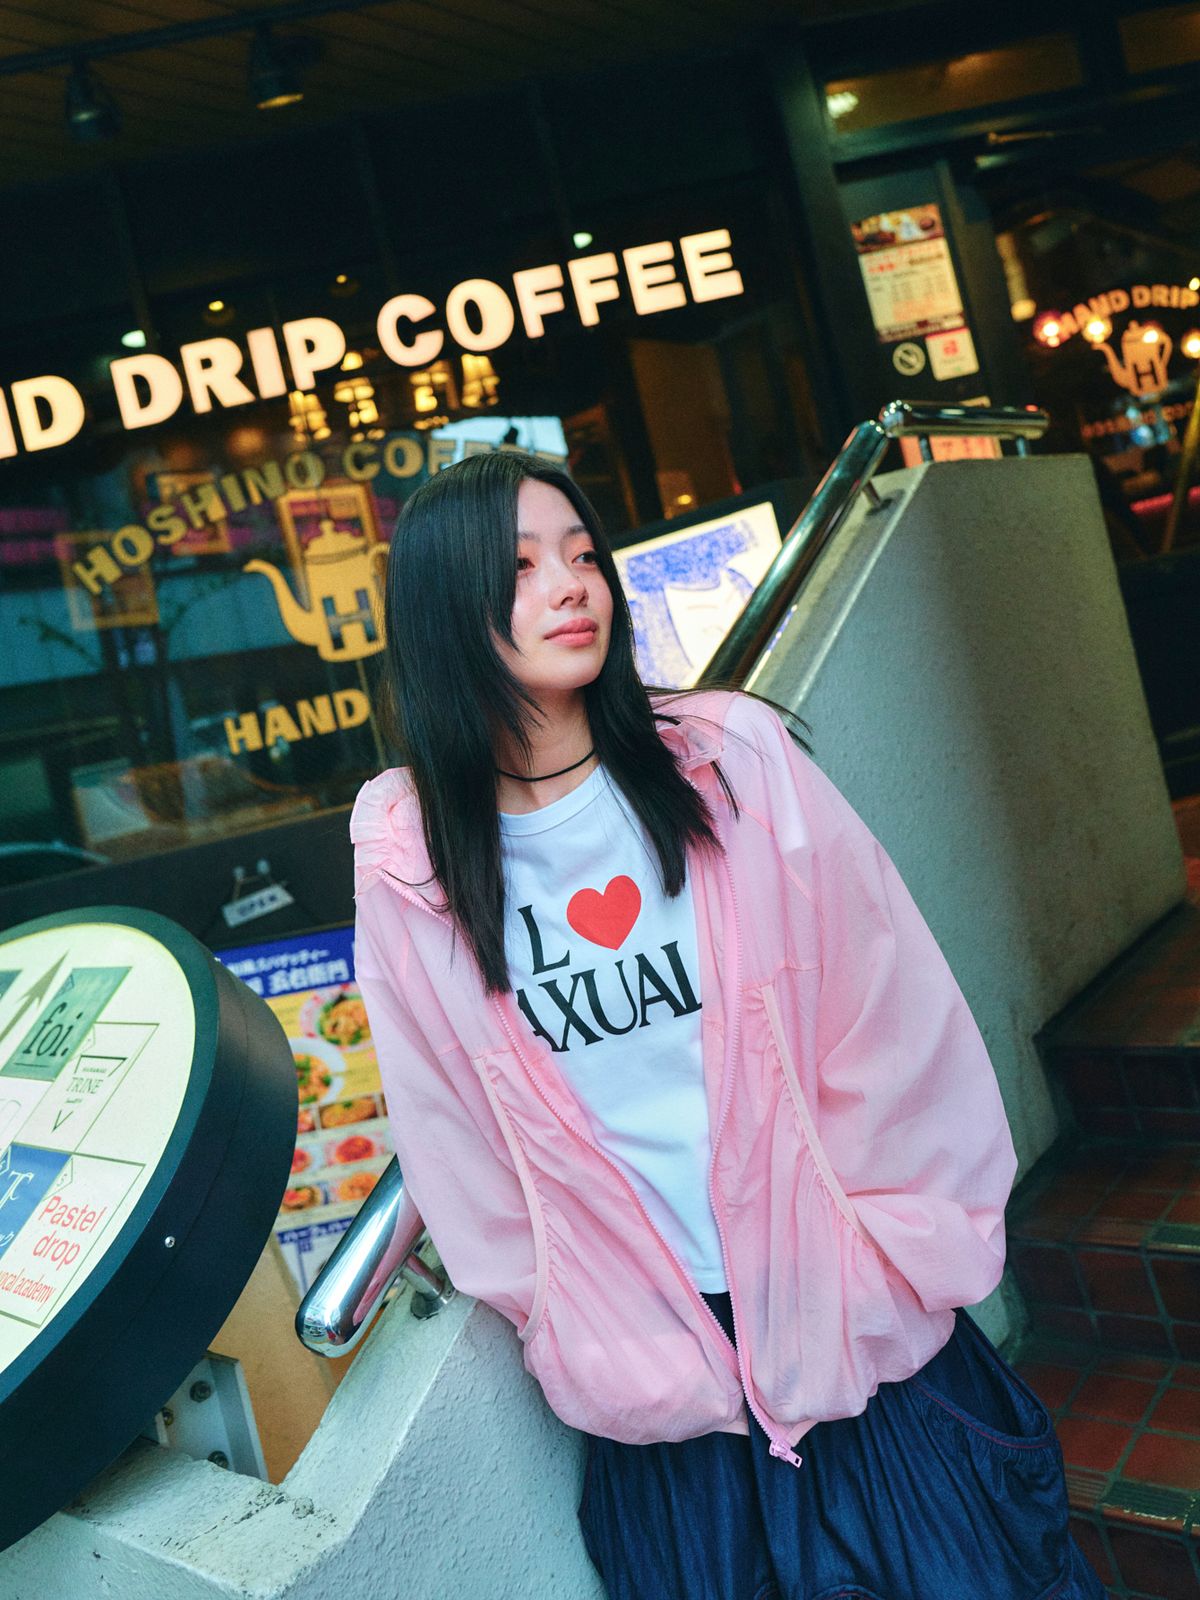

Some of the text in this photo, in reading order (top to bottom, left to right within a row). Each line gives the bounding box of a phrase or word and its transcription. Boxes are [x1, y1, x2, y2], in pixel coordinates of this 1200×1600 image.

[1131, 284, 1199, 309] DRIP
[110, 316, 346, 430] DRIP
[377, 228, 744, 367] COFFEE
[74, 451, 325, 595] HOSHINO
[225, 689, 371, 755] HAND
[517, 904, 570, 975] L
[66, 1077, 104, 1095] TRINE
[38, 1195, 108, 1233] Pastel
[33, 1230, 81, 1271] drop
[13, 1274, 57, 1312] academy
